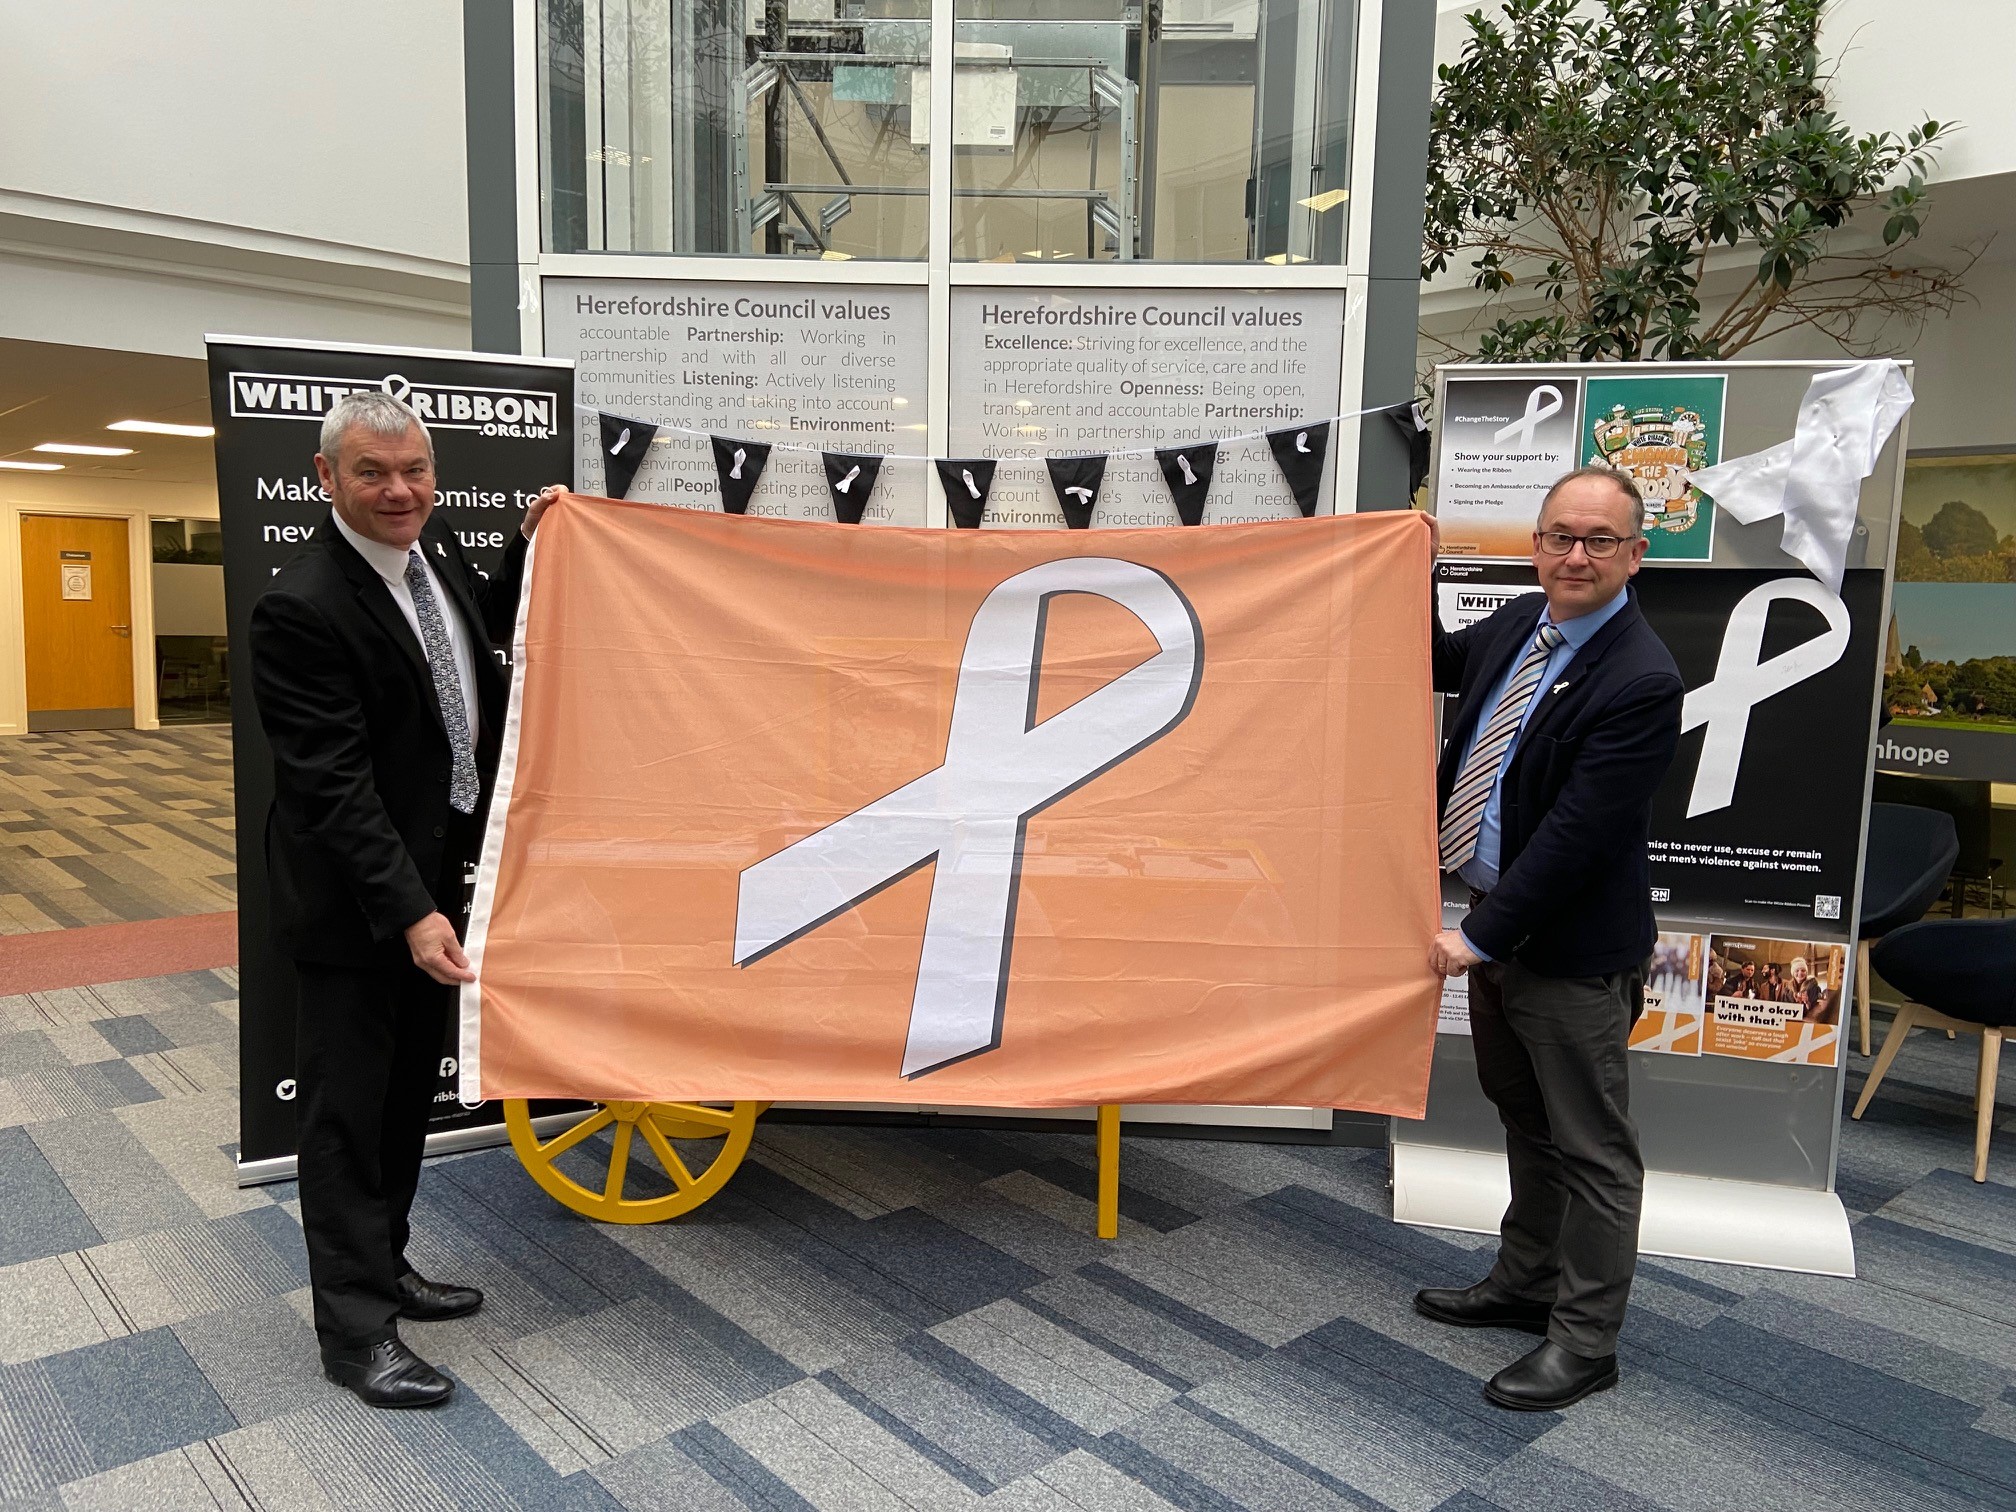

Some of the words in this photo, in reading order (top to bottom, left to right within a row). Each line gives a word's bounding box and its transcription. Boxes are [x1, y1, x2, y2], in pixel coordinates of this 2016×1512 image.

[576, 295, 729, 317] Herefordshire
[734, 298, 815, 318] Council
[821, 300, 891, 320] values
[982, 305, 1136, 325] Herefordshire
[1143, 306, 1225, 326] Council
[1232, 307, 1302, 326] values
[580, 326, 670, 340] accountable
[687, 326, 784, 346] Partnership:
[801, 330, 865, 347] Working
[883, 331, 896, 345] in
[984, 335, 1072, 349] Excellence:
[1077, 336, 1135, 354] Striving
[1139, 337, 1160, 351] for
[1164, 337, 1246, 353] excellence,
[1250, 337, 1277, 351] and
[1283, 337, 1307, 351] the
[580, 348, 667, 365] partnership
[681, 350, 708, 363] and
[723, 350, 756, 364] with
[770, 351, 786, 365] all
[801, 355, 827, 366] our
[841, 352, 895, 367] diverse
[984, 358, 1072, 374] appropriate
[1077, 358, 1128, 375] quality
[1132, 359, 1147, 373] of
[1152, 359, 1208, 374] service,
[1213, 363, 1245, 373] care
[1251, 360, 1278, 373] and
[1283, 360, 1306, 374] life
[580, 370, 675, 384] communities
[683, 371, 758, 388] Listening:
[766, 373, 825, 389] Actively
[833, 374, 895, 392] listening
[984, 379, 996, 393] in
[1005, 380, 1112, 394] Herefordshire
[1120, 380, 1204, 398] Openness:
[1213, 381, 1255, 399] Being
[1263, 385, 1305, 398] open,
[237, 382, 369, 409] WHIT
[412, 392, 548, 425] RIBBON
[581, 391, 599, 405] to,
[605, 392, 713, 410] understanding
[718, 394, 745, 407] and
[752, 394, 796, 411] taking
[803, 396, 830, 409] into
[837, 399, 895, 411] account
[984, 402, 1071, 418] transparent
[1076, 403, 1103, 416] and
[1108, 404, 1200, 417] accountable
[1205, 403, 1303, 420] Partnership:
[1454, 416, 1510, 424] #ChangeTheStory
[478, 423, 549, 439] .ORG.UK
[650, 415, 692, 428] views
[701, 415, 727, 428] and
[738, 417, 780, 430] needs
[790, 417, 895, 432] Environment:
[982, 423, 1047, 440] Working
[1057, 424, 1068, 438] in
[1078, 425, 1165, 441] partnership
[1173, 426, 1200, 439] and
[1631, 435, 1646, 446] WHITE
[982, 445, 1036, 458] diverse
[1506, 454, 1542, 462] support
[1545, 453, 1559, 462] by:
[641, 459, 717, 471] environme
[775, 461, 826, 477] heritag
[1639, 466, 1661, 477] THE
[1221, 470, 1265, 486] taking
[1632, 467, 1689, 499] TORY
[638, 478, 656, 491] of
[753, 482, 797, 497] eating
[871, 484, 895, 498] rly,
[987, 490, 1040, 502] ccount
[1206, 492, 1232, 504] and
[434, 486, 506, 509] omise
[750, 503, 788, 516] spect
[803, 503, 829, 516] and
[982, 509, 1065, 523] Environme
[1097, 511, 1172, 527] Protecting
[264, 523, 314, 542] nev
[455, 531, 504, 548] use
[1461, 597, 1513, 608] WHIT
[1876, 739, 1949, 766] nhope
[1671, 842, 1681, 850] to
[1684, 844, 1711, 852] never
[1714, 846, 1734, 855] use,
[1736, 847, 1769, 856] excuse
[1772, 849, 1784, 857] or
[1786, 849, 1822, 860] remain
[1669, 856, 1697, 864] men's
[1700, 857, 1740, 867] violence
[1743, 860, 1778, 870] against
[1781, 863, 1822, 872] women.
[1719, 1000, 1739, 1010] 'I'm
[1744, 1004, 1764, 1012] not
[1769, 1006, 1799, 1017] okay
[1718, 1013, 1744, 1022] with
[1750, 1016, 1782, 1026] that.'
